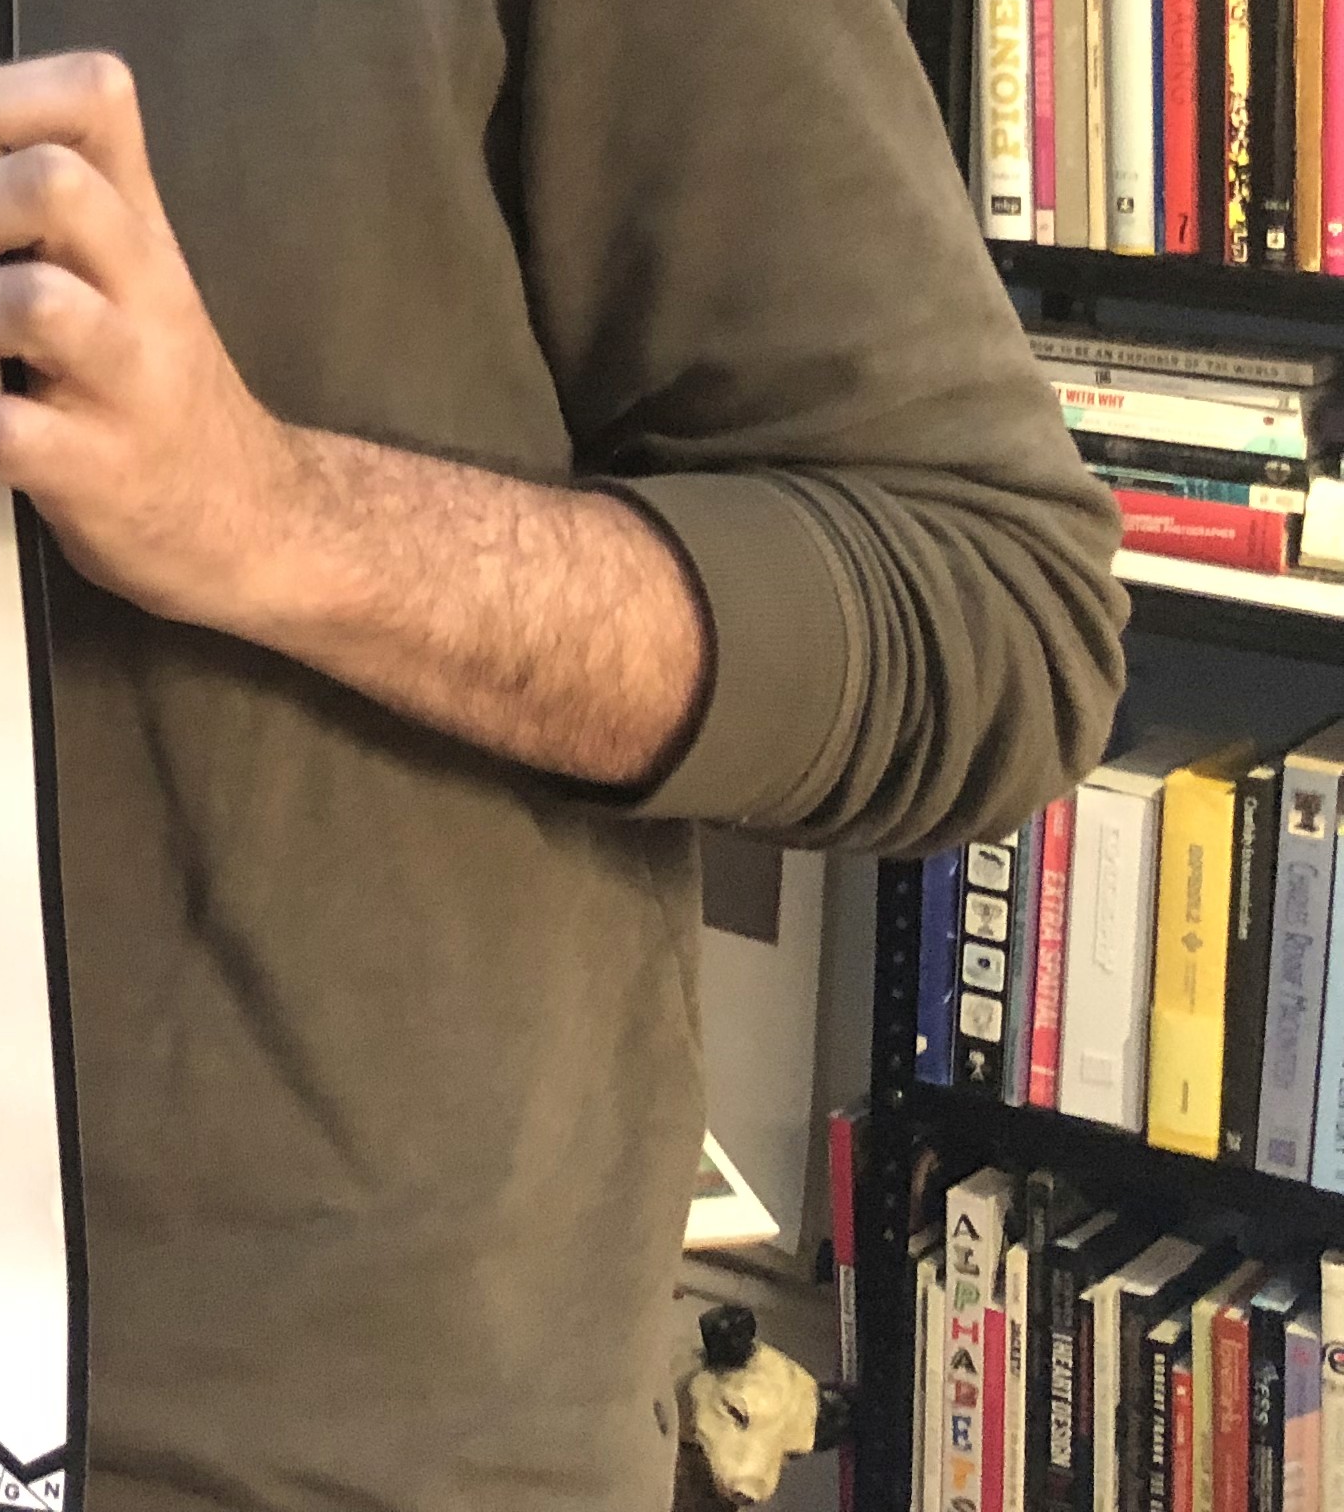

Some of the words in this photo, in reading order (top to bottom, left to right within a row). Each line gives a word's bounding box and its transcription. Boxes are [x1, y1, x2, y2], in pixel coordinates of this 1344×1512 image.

[1066, 389, 1095, 405] WITH
[1098, 394, 1125, 408] WHY
[1041, 869, 1065, 941] EXTRA
[1034, 947, 1061, 1031] SPATIAL
[1052, 1344, 1073, 1401] HEART
[1051, 1402, 1071, 1467] DESIGN
